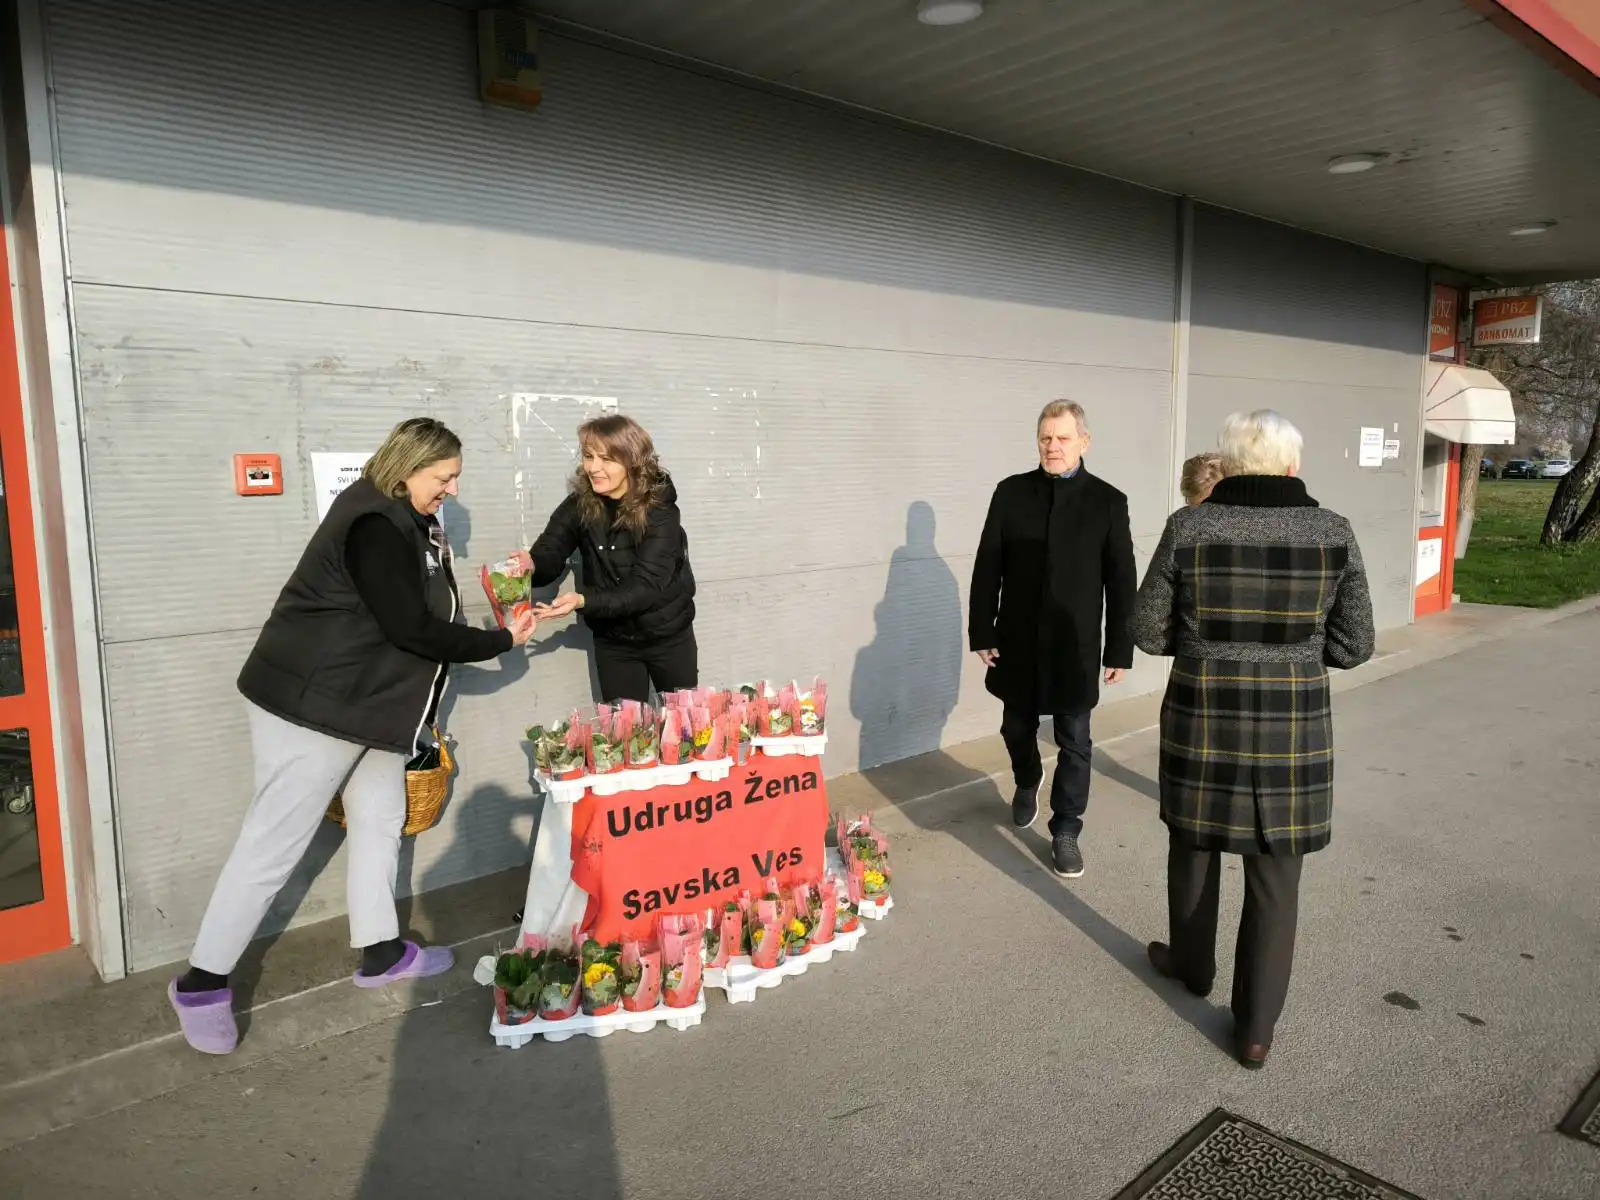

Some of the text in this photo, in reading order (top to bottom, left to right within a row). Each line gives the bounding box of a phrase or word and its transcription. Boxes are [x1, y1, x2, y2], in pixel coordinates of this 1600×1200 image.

[1501, 302, 1529, 314] PBZ
[1478, 328, 1530, 341] BANKOMAT
[607, 770, 818, 838] Udruga Žena
[622, 846, 804, 920] Savska Ves
